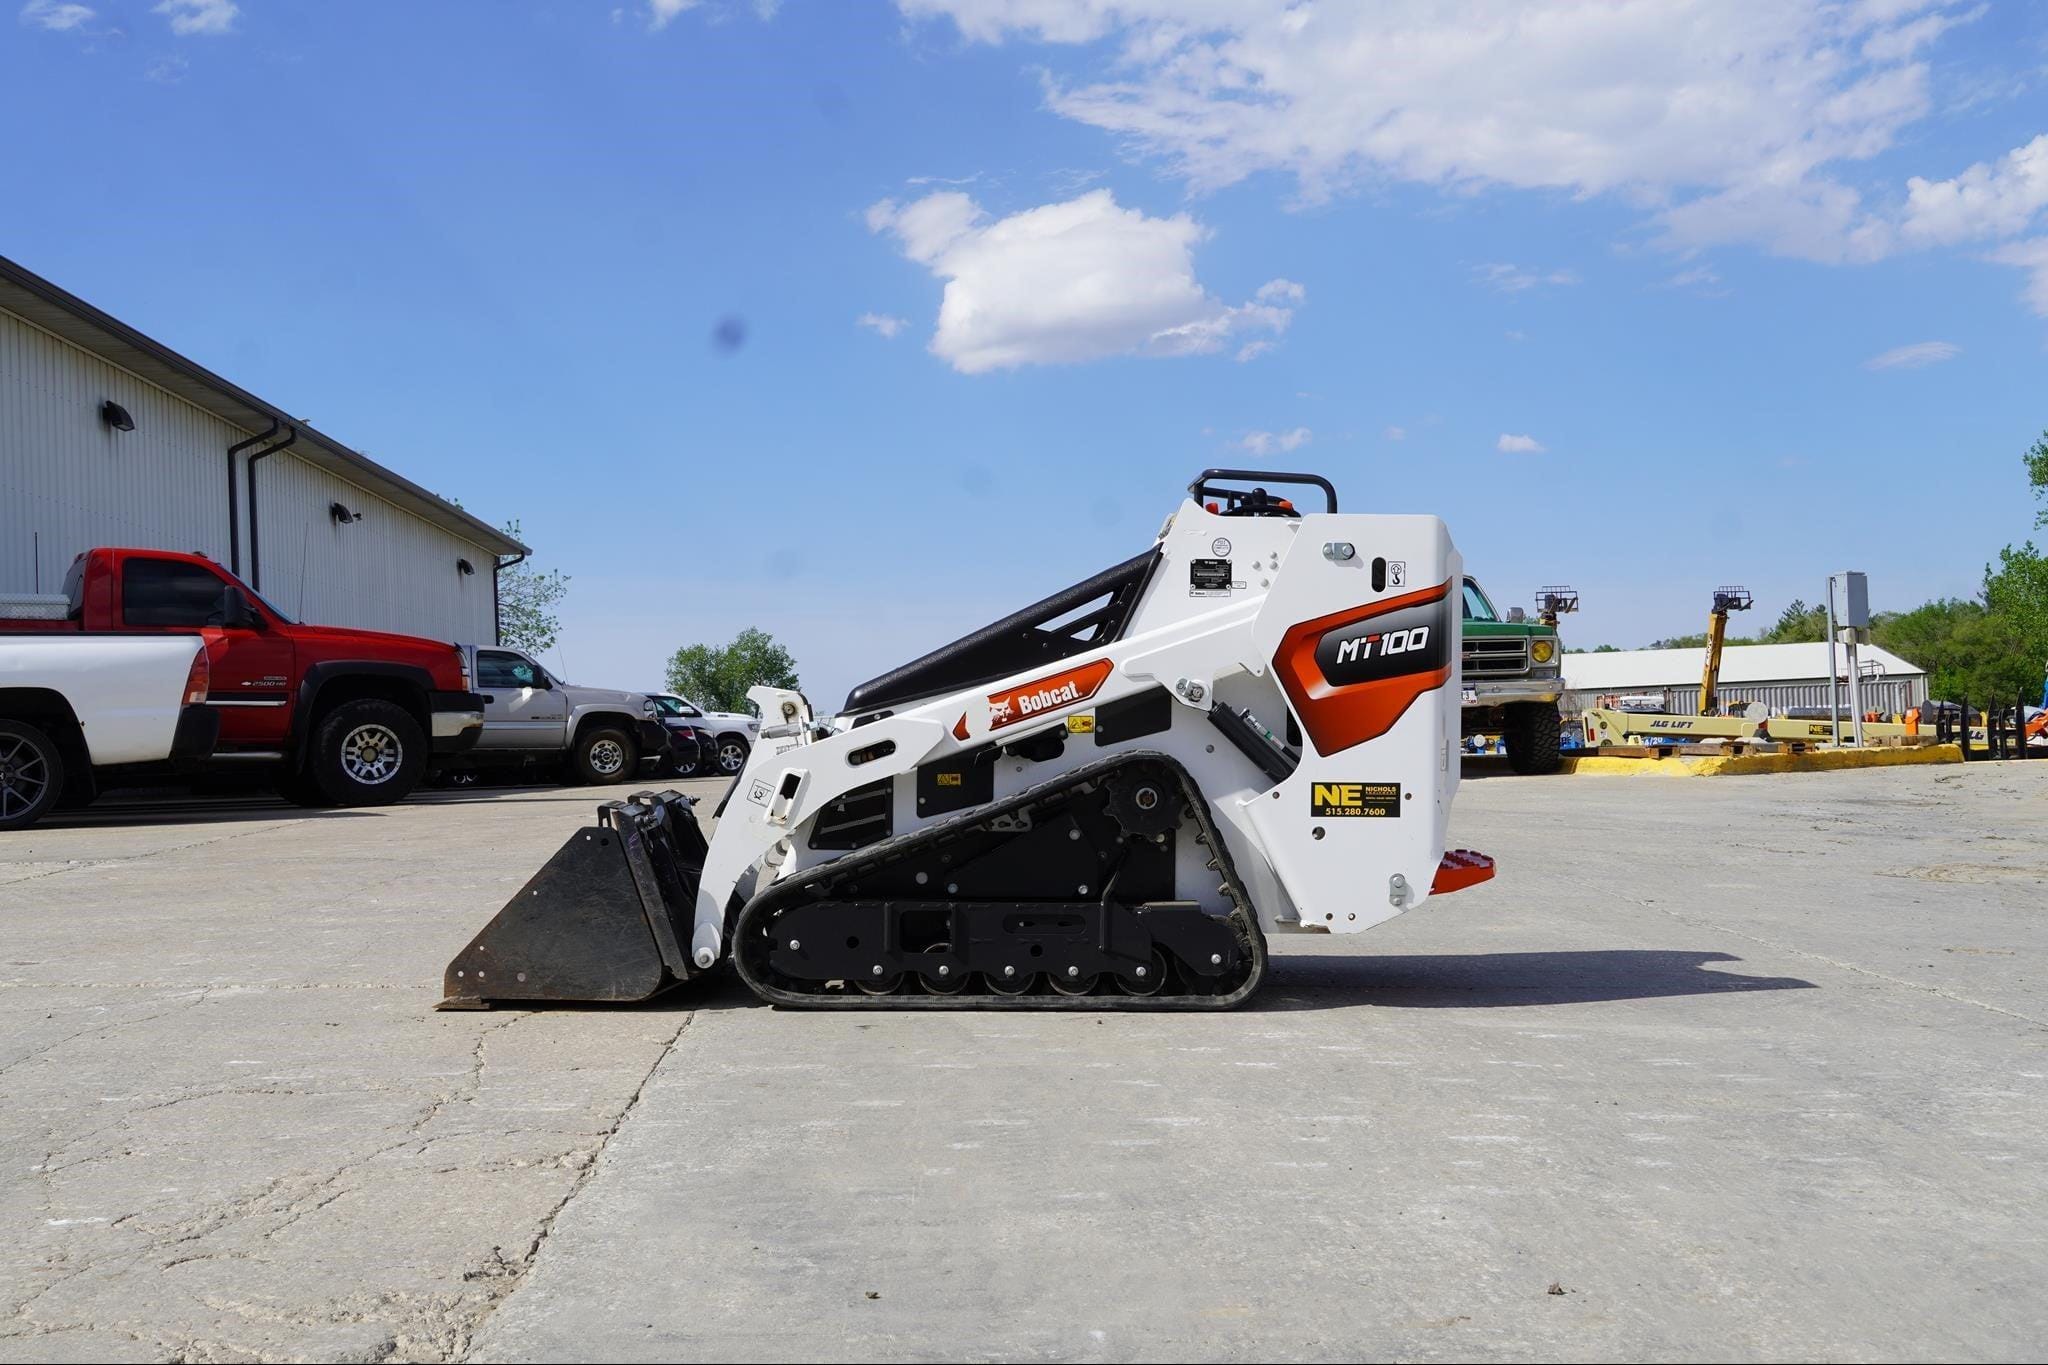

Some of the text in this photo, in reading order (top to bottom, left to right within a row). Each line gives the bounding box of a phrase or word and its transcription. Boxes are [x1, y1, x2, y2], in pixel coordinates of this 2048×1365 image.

[1336, 626, 1430, 665] MT100
[1017, 680, 1080, 715] Bobcat
[1649, 720, 1694, 729] JLG LIFT
[1314, 784, 1363, 806] NE
[1325, 807, 1386, 816] 515.280.7600
